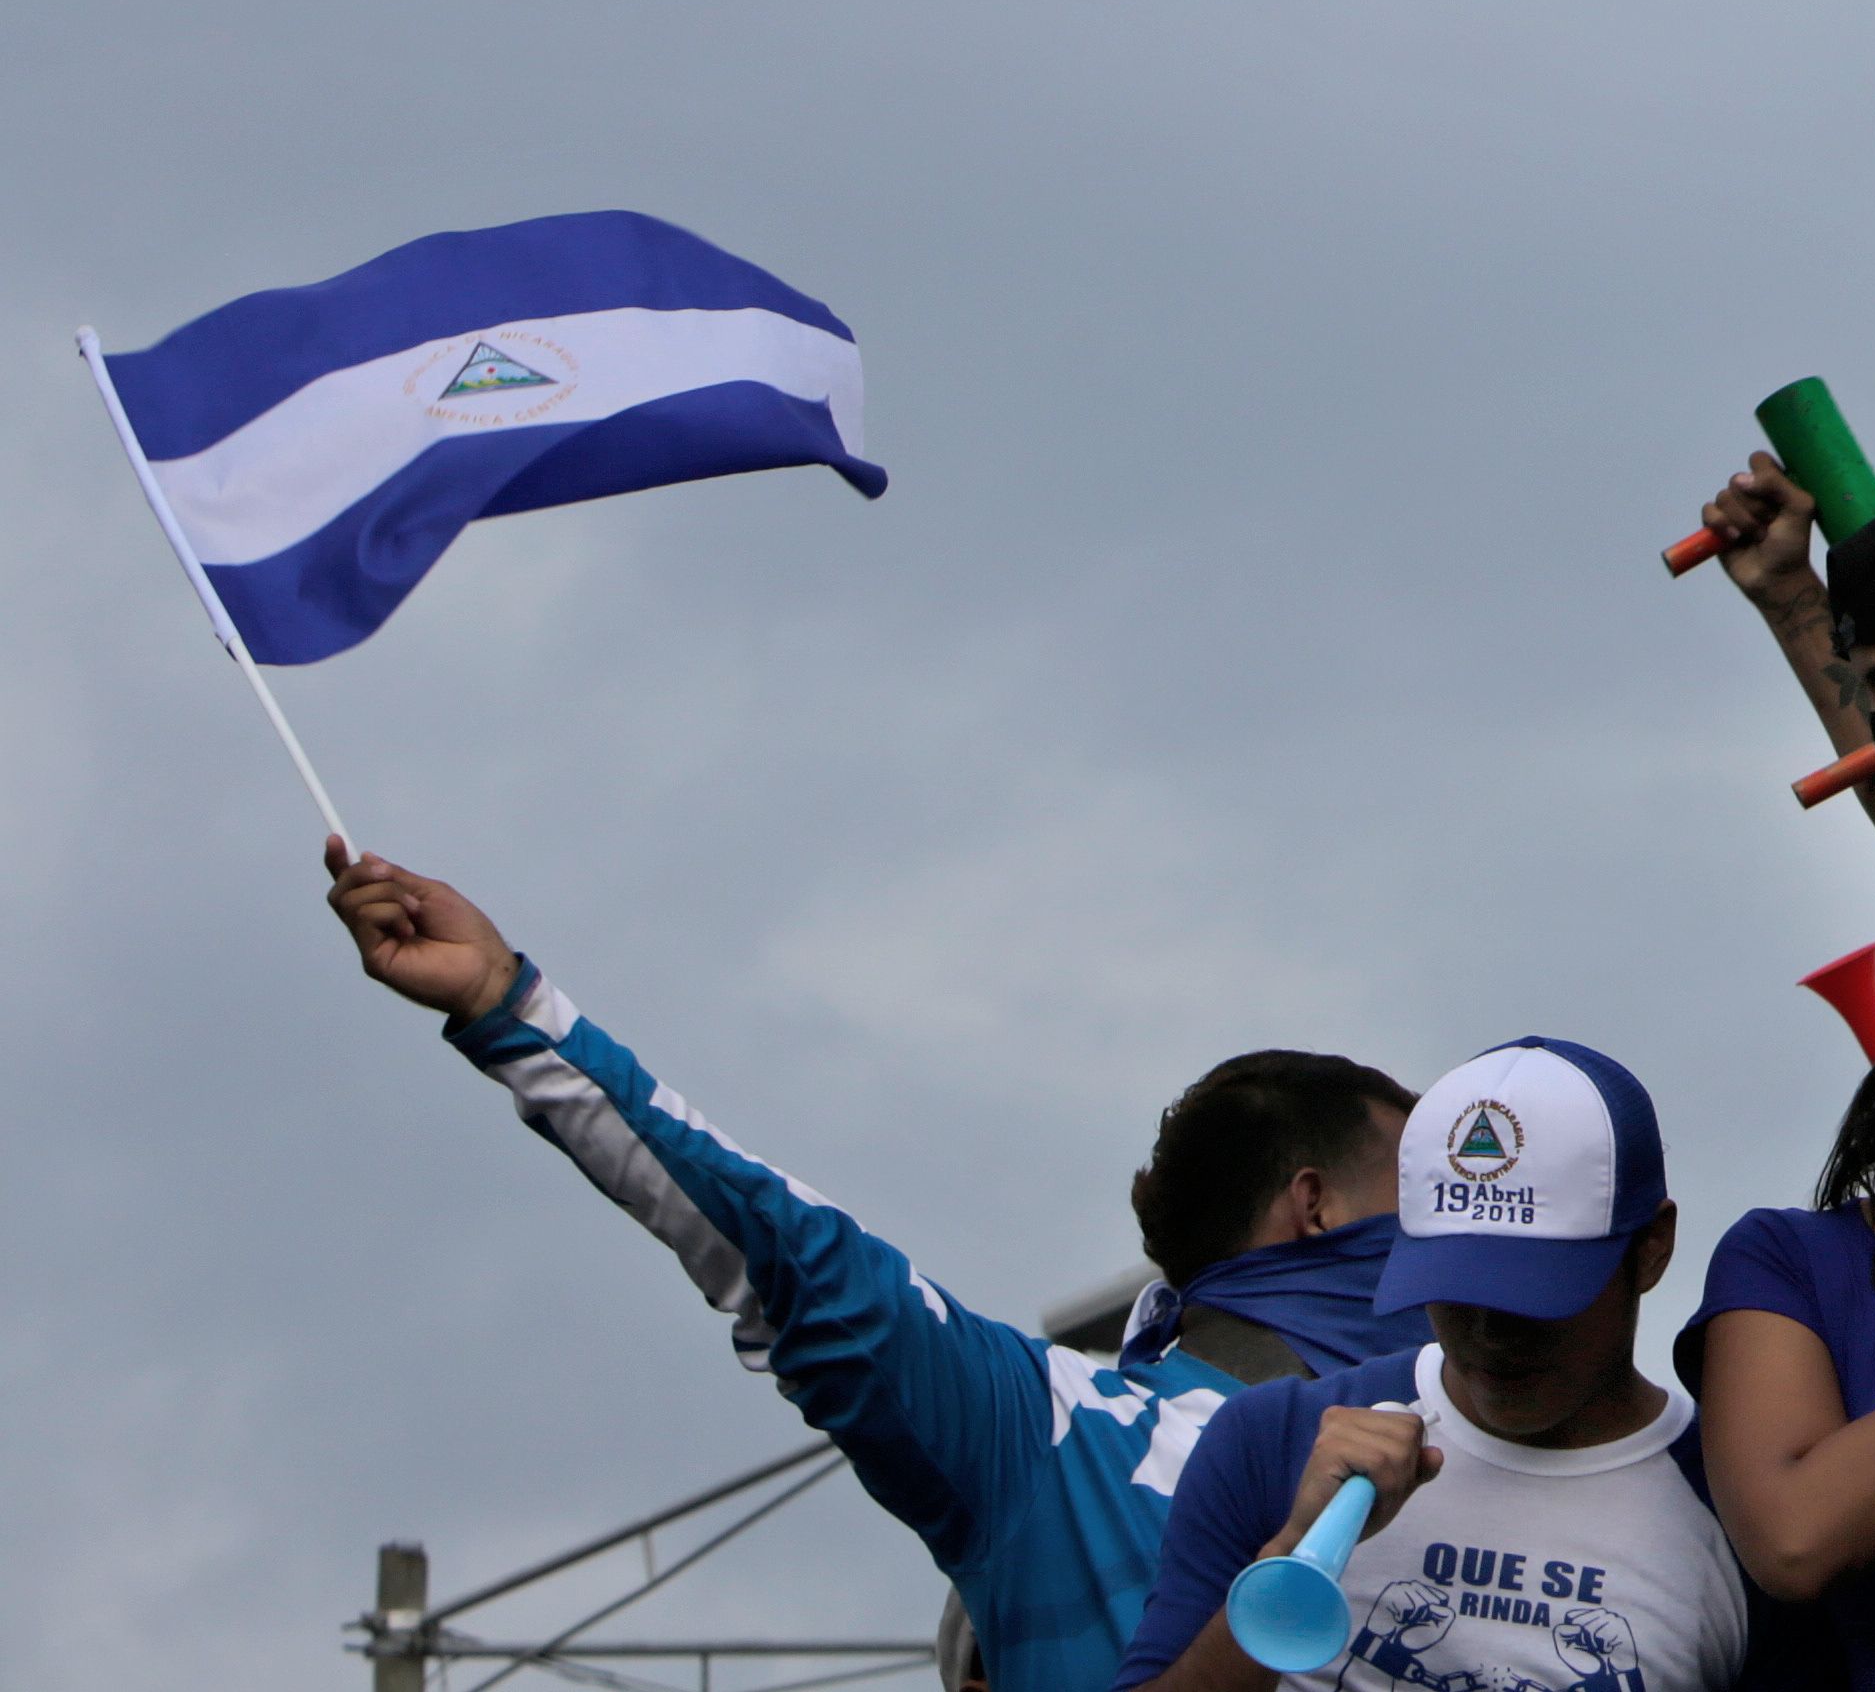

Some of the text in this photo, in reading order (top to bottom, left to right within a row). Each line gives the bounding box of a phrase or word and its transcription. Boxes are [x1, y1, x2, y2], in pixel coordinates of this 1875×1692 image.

[1433, 1182, 1534, 1212] 19 Abril
[1471, 1204, 1534, 1224] 2018
[1423, 1542, 1606, 1604] QUE SE
[1458, 1591, 1551, 1628] RINDA
